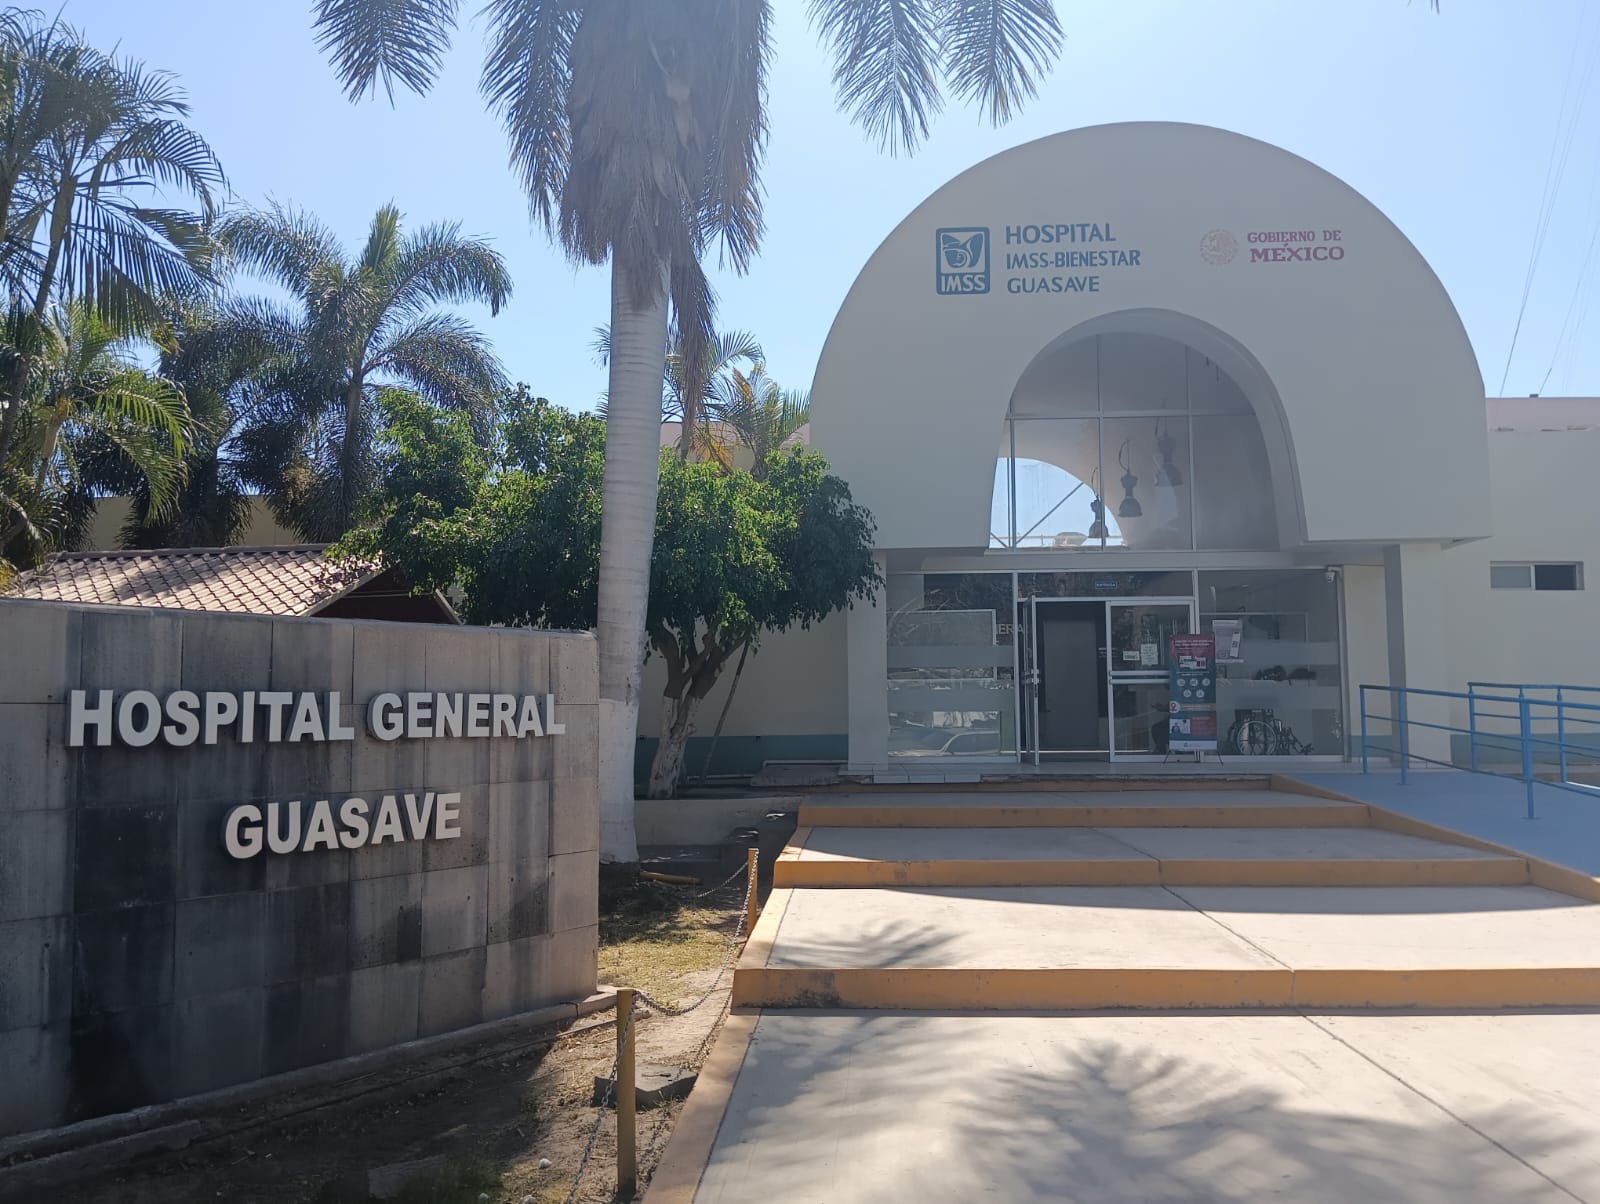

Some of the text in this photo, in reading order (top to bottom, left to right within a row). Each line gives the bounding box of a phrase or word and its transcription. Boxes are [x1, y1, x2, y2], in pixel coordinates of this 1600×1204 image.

[1005, 223, 1116, 245] HOSPITAL
[1247, 229, 1342, 243] GOBIERNO DE
[1006, 249, 1141, 270] IMSS-BIENESTAR
[1249, 243, 1345, 263] MÉXICO
[941, 274, 986, 292] IMSS
[1006, 275, 1100, 295] GUASAVE
[68, 689, 566, 748] HOSPITAL GENERAL
[223, 792, 462, 860] GUASAVE
